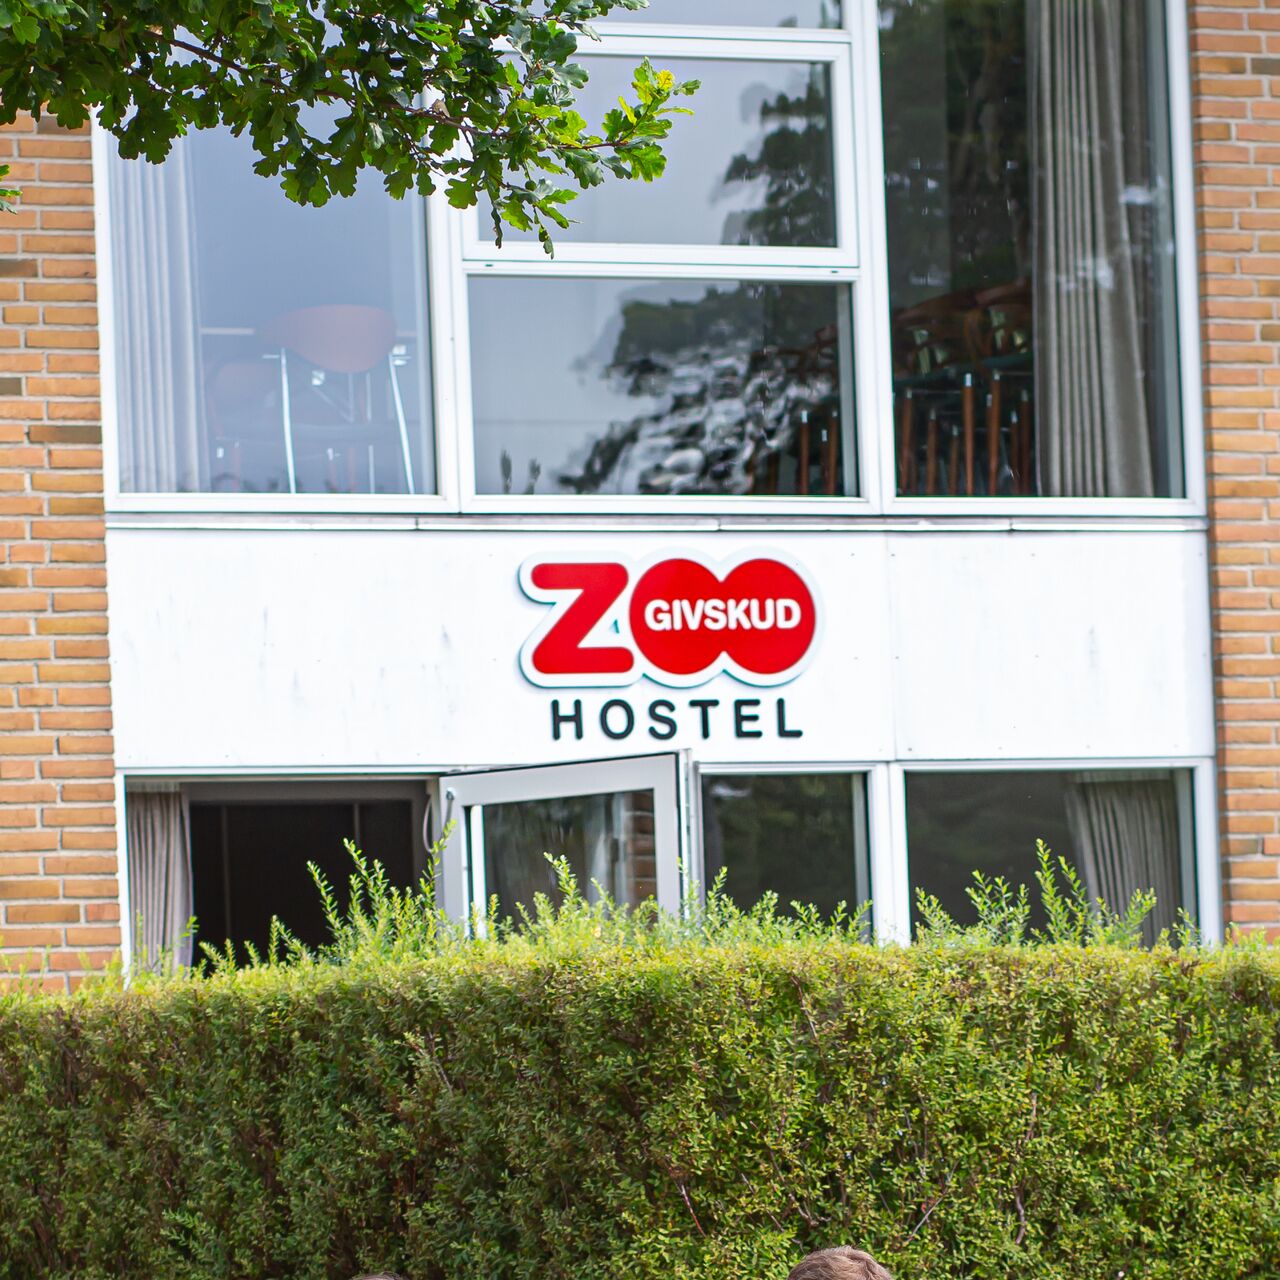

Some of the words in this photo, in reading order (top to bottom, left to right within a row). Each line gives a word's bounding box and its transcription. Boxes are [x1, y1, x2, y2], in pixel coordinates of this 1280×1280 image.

[531, 558, 817, 675] ZOO
[644, 598, 802, 632] GIVSKUD
[551, 698, 804, 741] HOSTEL
